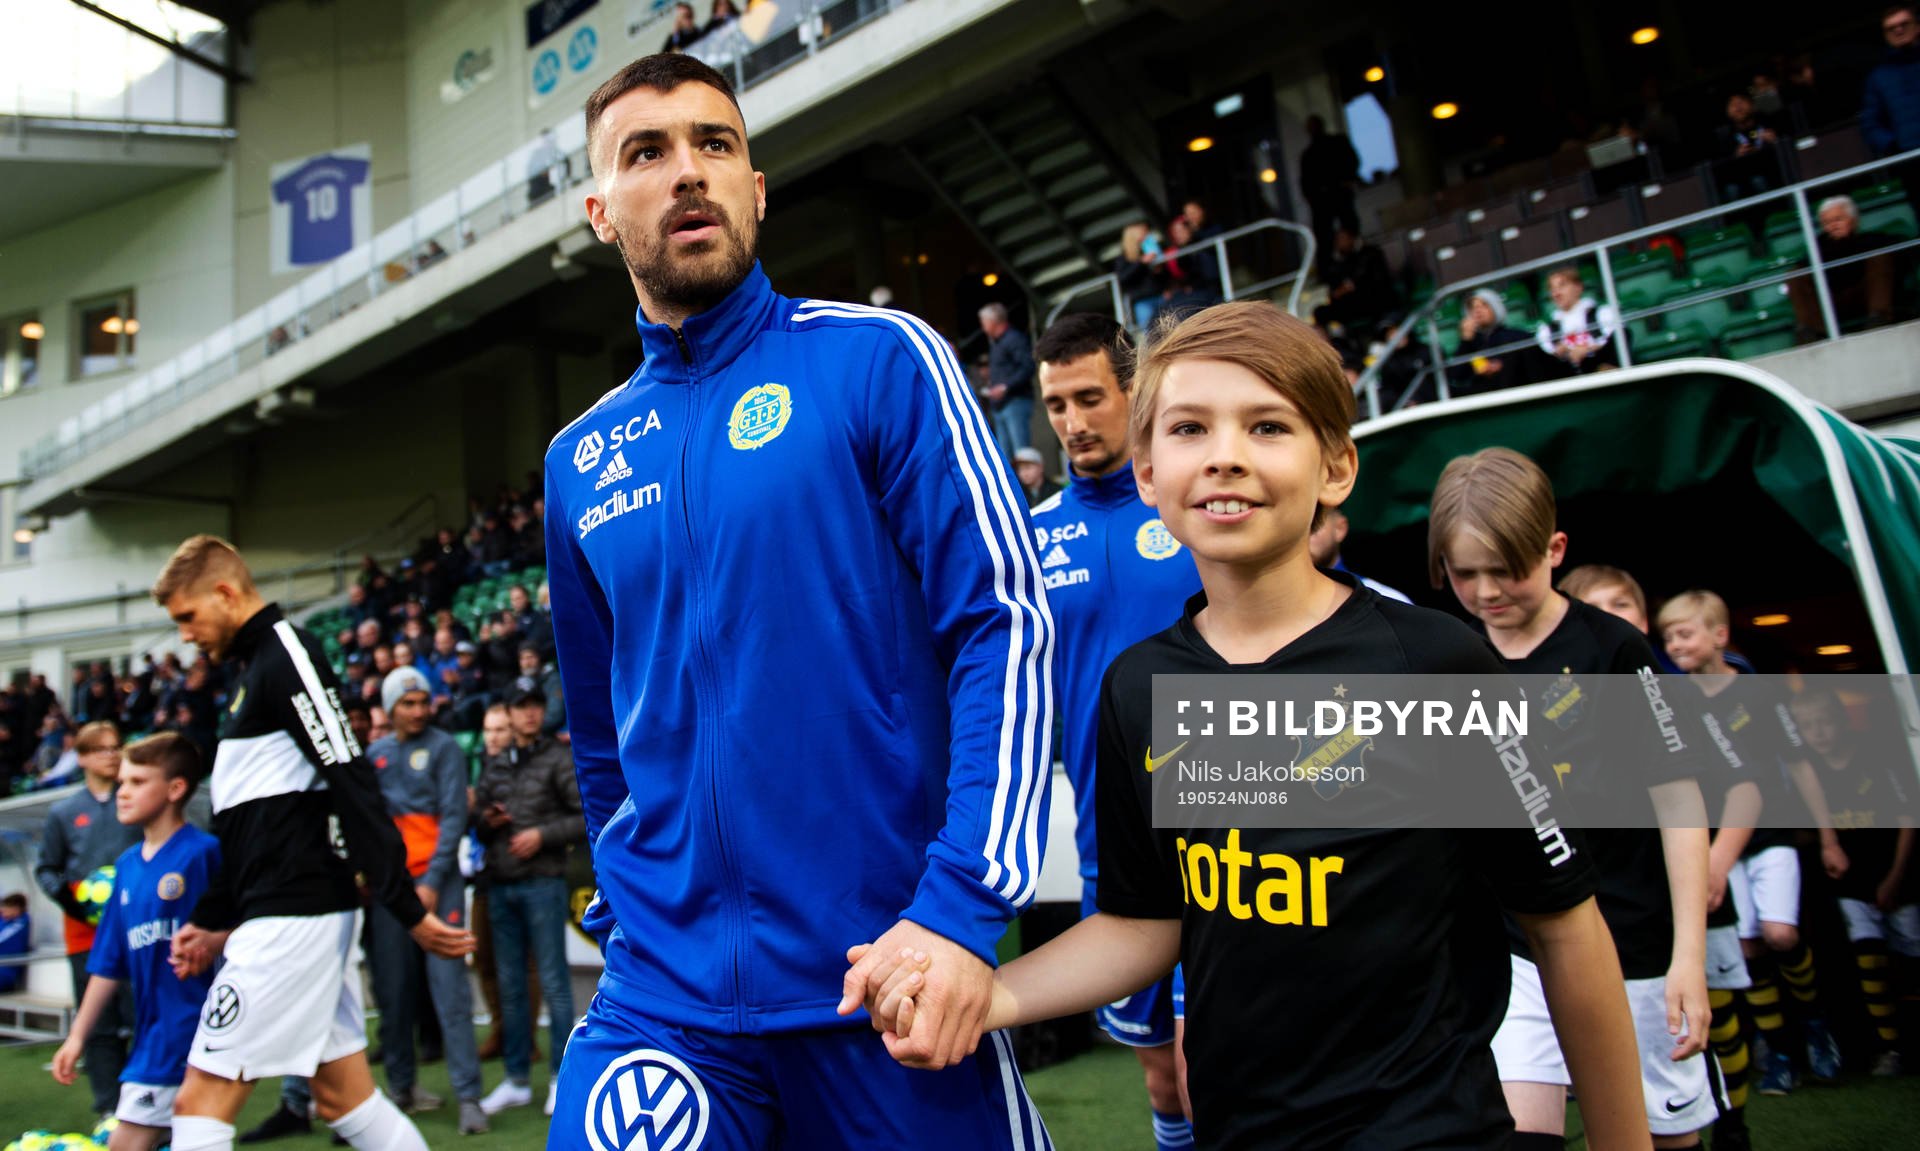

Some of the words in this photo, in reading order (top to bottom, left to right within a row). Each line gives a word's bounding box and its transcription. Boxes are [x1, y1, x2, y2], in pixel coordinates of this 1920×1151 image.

[306, 185, 338, 222] 10
[609, 408, 662, 450] SCA
[595, 467, 633, 491] adidas
[578, 482, 662, 539] stadium
[1051, 521, 1088, 543] SCA
[1043, 568, 1090, 590] dium
[1636, 665, 1687, 753] stadium
[1488, 716, 1572, 867] stadium
